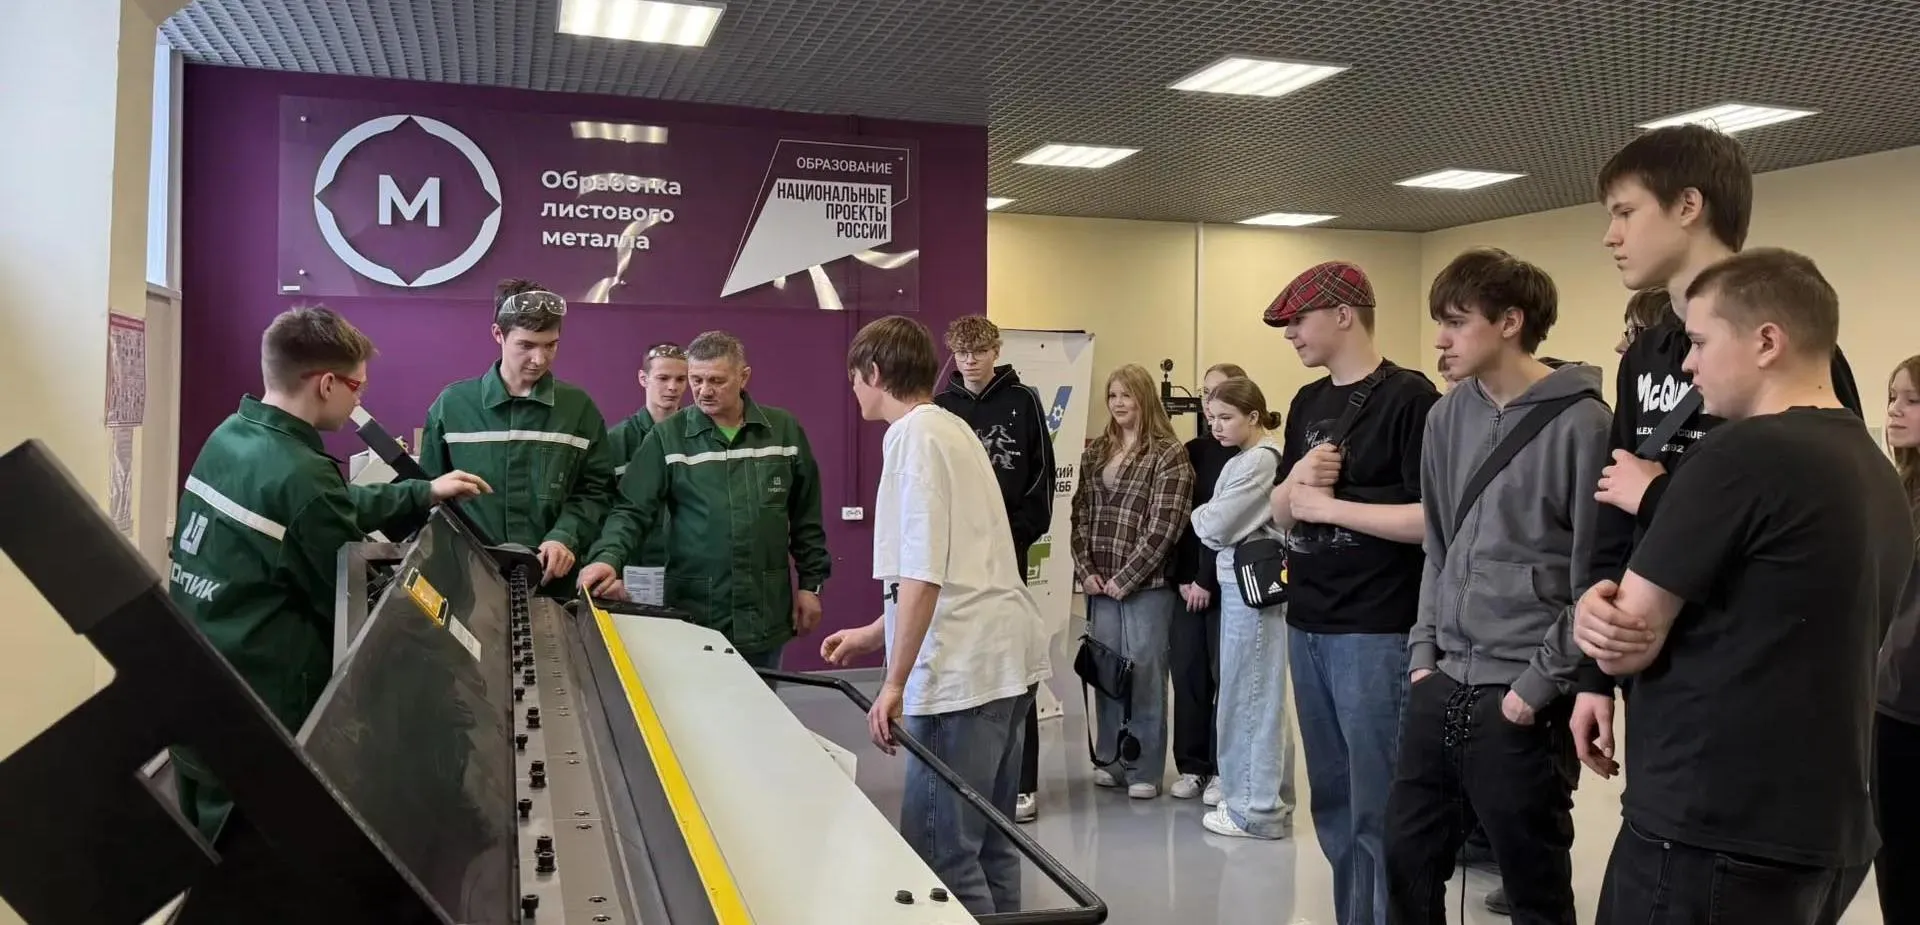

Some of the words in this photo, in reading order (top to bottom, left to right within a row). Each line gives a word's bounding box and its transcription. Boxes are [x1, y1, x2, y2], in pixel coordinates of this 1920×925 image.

[796, 156, 893, 174] ОБРАЗОВАНИЕ
[541, 170, 682, 195] Обработка
[378, 174, 440, 227] М
[777, 182, 887, 204] НАЦИОНАЛЬНЫЕ
[541, 202, 675, 223] листового
[825, 203, 887, 222] ПРОЕКТЫ
[542, 230, 650, 250] металла
[837, 222, 887, 240] РОССИИ
